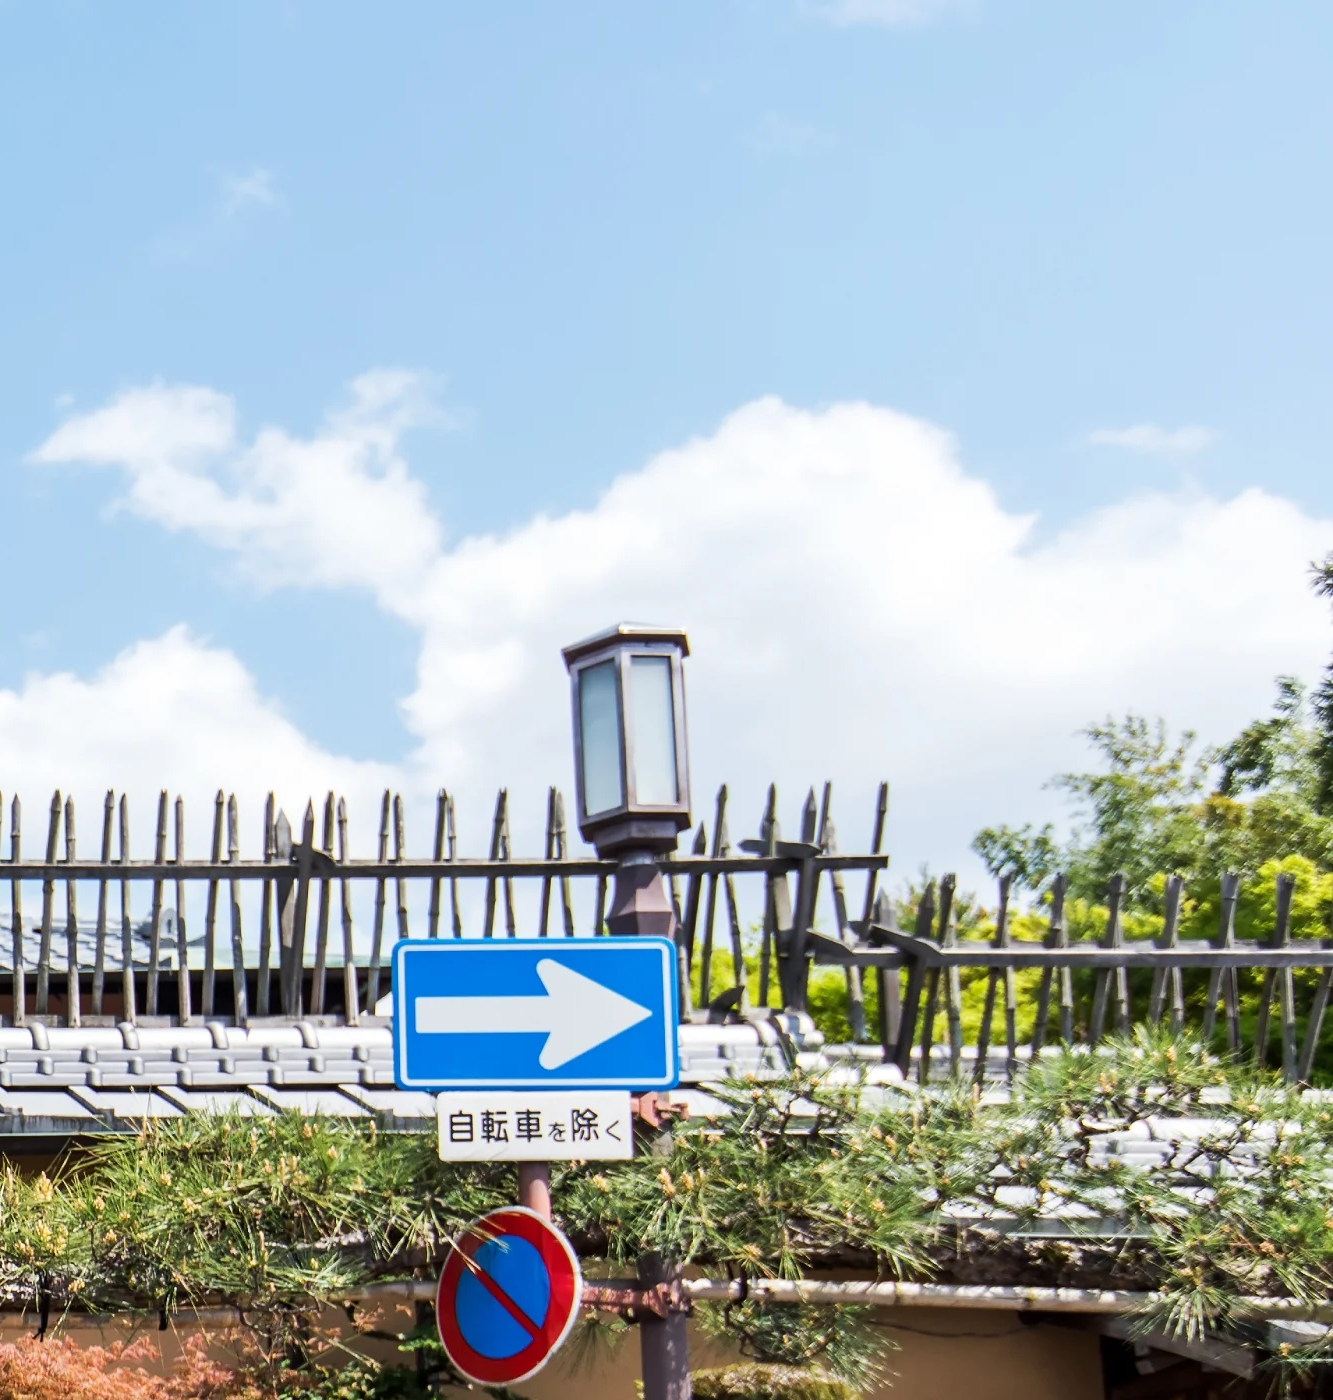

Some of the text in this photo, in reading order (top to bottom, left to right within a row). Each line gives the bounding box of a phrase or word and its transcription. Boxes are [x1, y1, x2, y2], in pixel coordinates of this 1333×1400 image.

[449, 1109, 622, 1144] 自転車を除く
